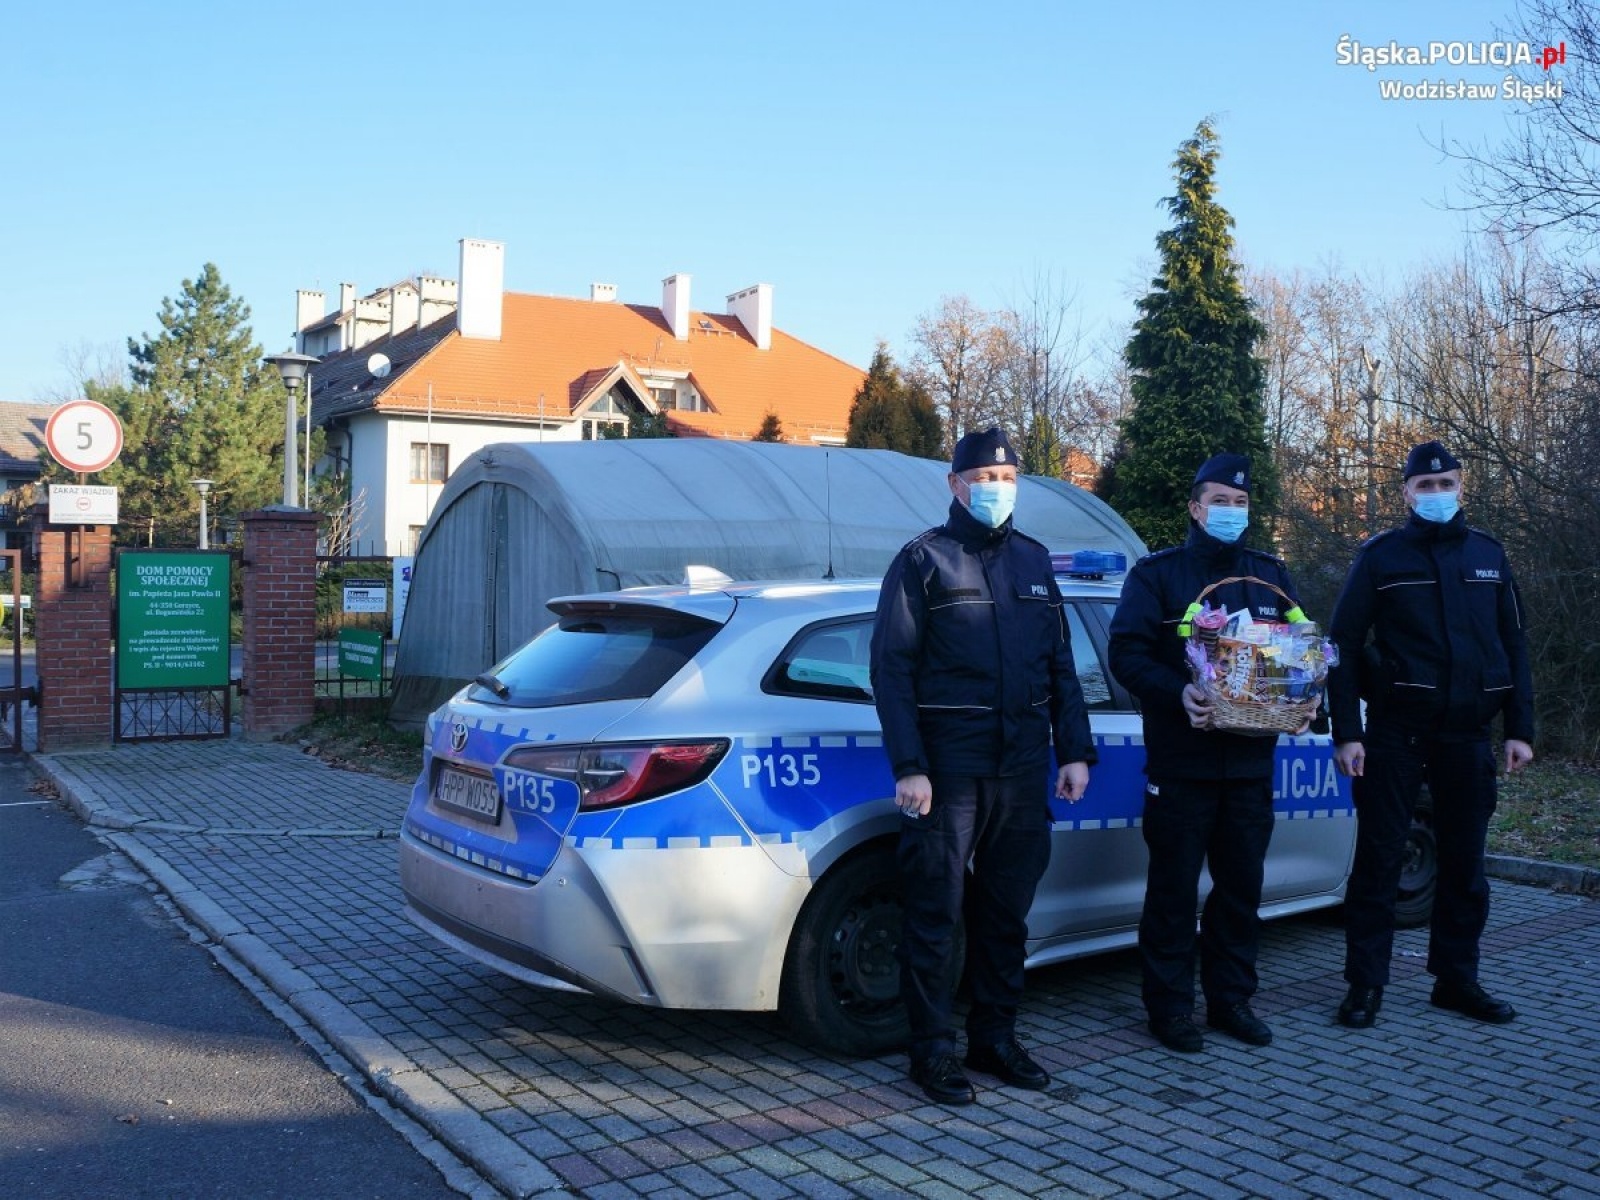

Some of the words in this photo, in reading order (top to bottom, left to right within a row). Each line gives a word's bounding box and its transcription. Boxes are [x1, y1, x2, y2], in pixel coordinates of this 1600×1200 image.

[77, 422, 93, 451] 5
[81, 488, 114, 496] WJAZDU
[136, 566, 163, 576] DOM
[166, 566, 214, 576] POMOCY
[140, 575, 209, 588] SPOŁECZNEJ
[740, 753, 821, 789] P135
[1273, 758, 1340, 799] ICJA
[503, 771, 556, 813] P135
